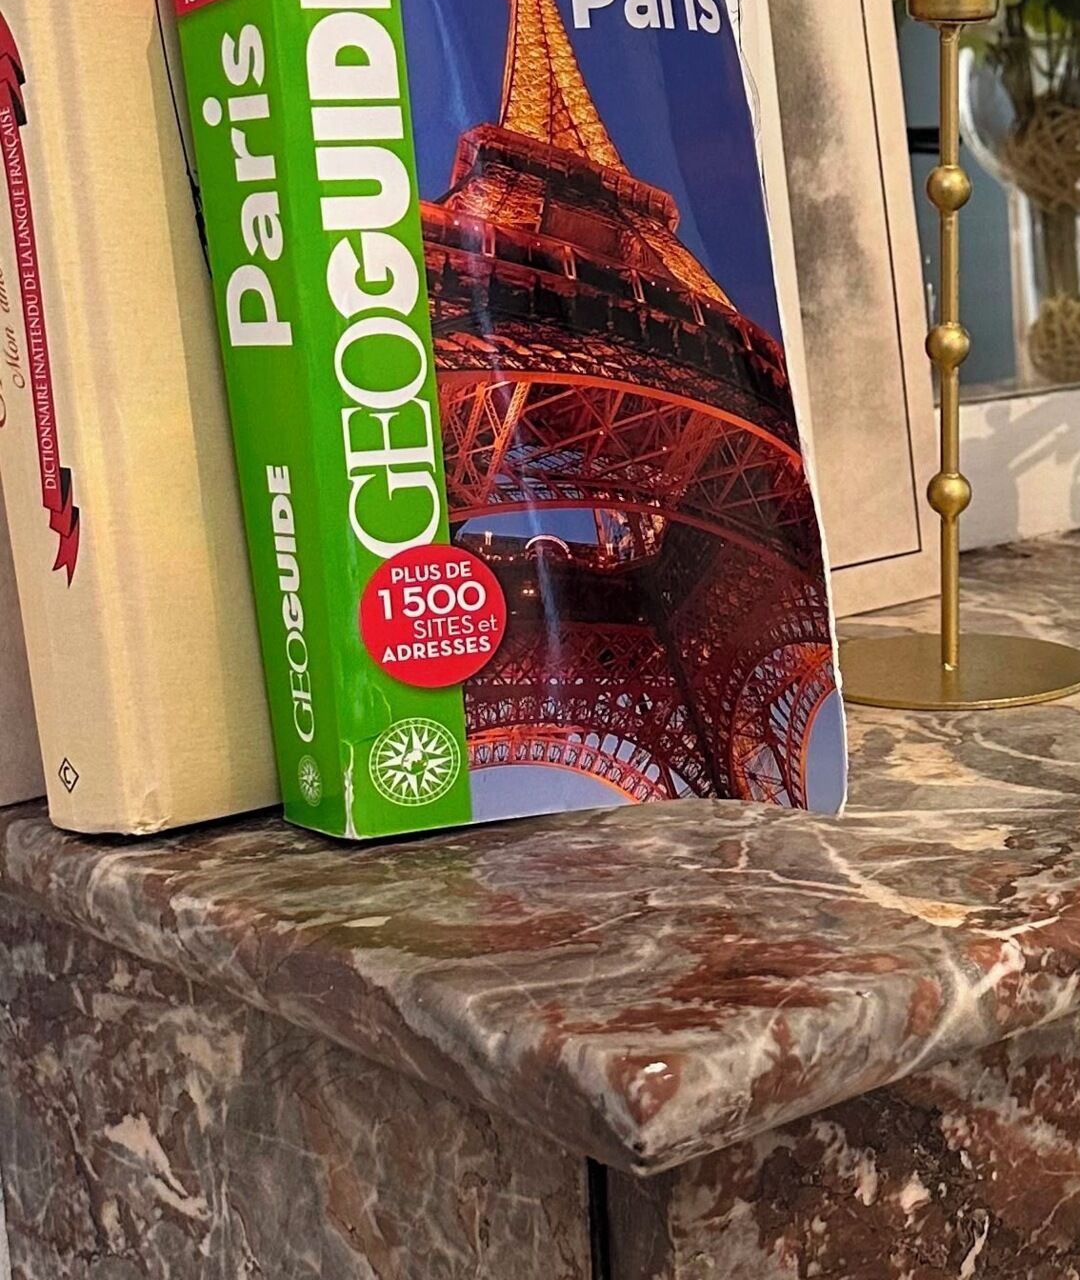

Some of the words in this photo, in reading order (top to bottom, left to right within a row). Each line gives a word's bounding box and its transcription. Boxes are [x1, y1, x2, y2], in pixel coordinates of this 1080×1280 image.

[1, 106, 24, 185] FRANÇAISE
[202, 24, 293, 347] Paris
[14, 188, 32, 247] LANGUE
[22, 251, 33, 268] LA
[23, 271, 36, 291] DE
[26, 294, 47, 380] INATTENDU
[36, 383, 57, 489] DICTIONNAIRE
[391, 564, 442, 584] PLUS
[445, 561, 472, 579] DE
[266, 464, 315, 743] GEOGUIDE
[413, 615, 475, 639] SITES
[478, 614, 498, 632] et
[382, 635, 491, 663] ADRESSES
